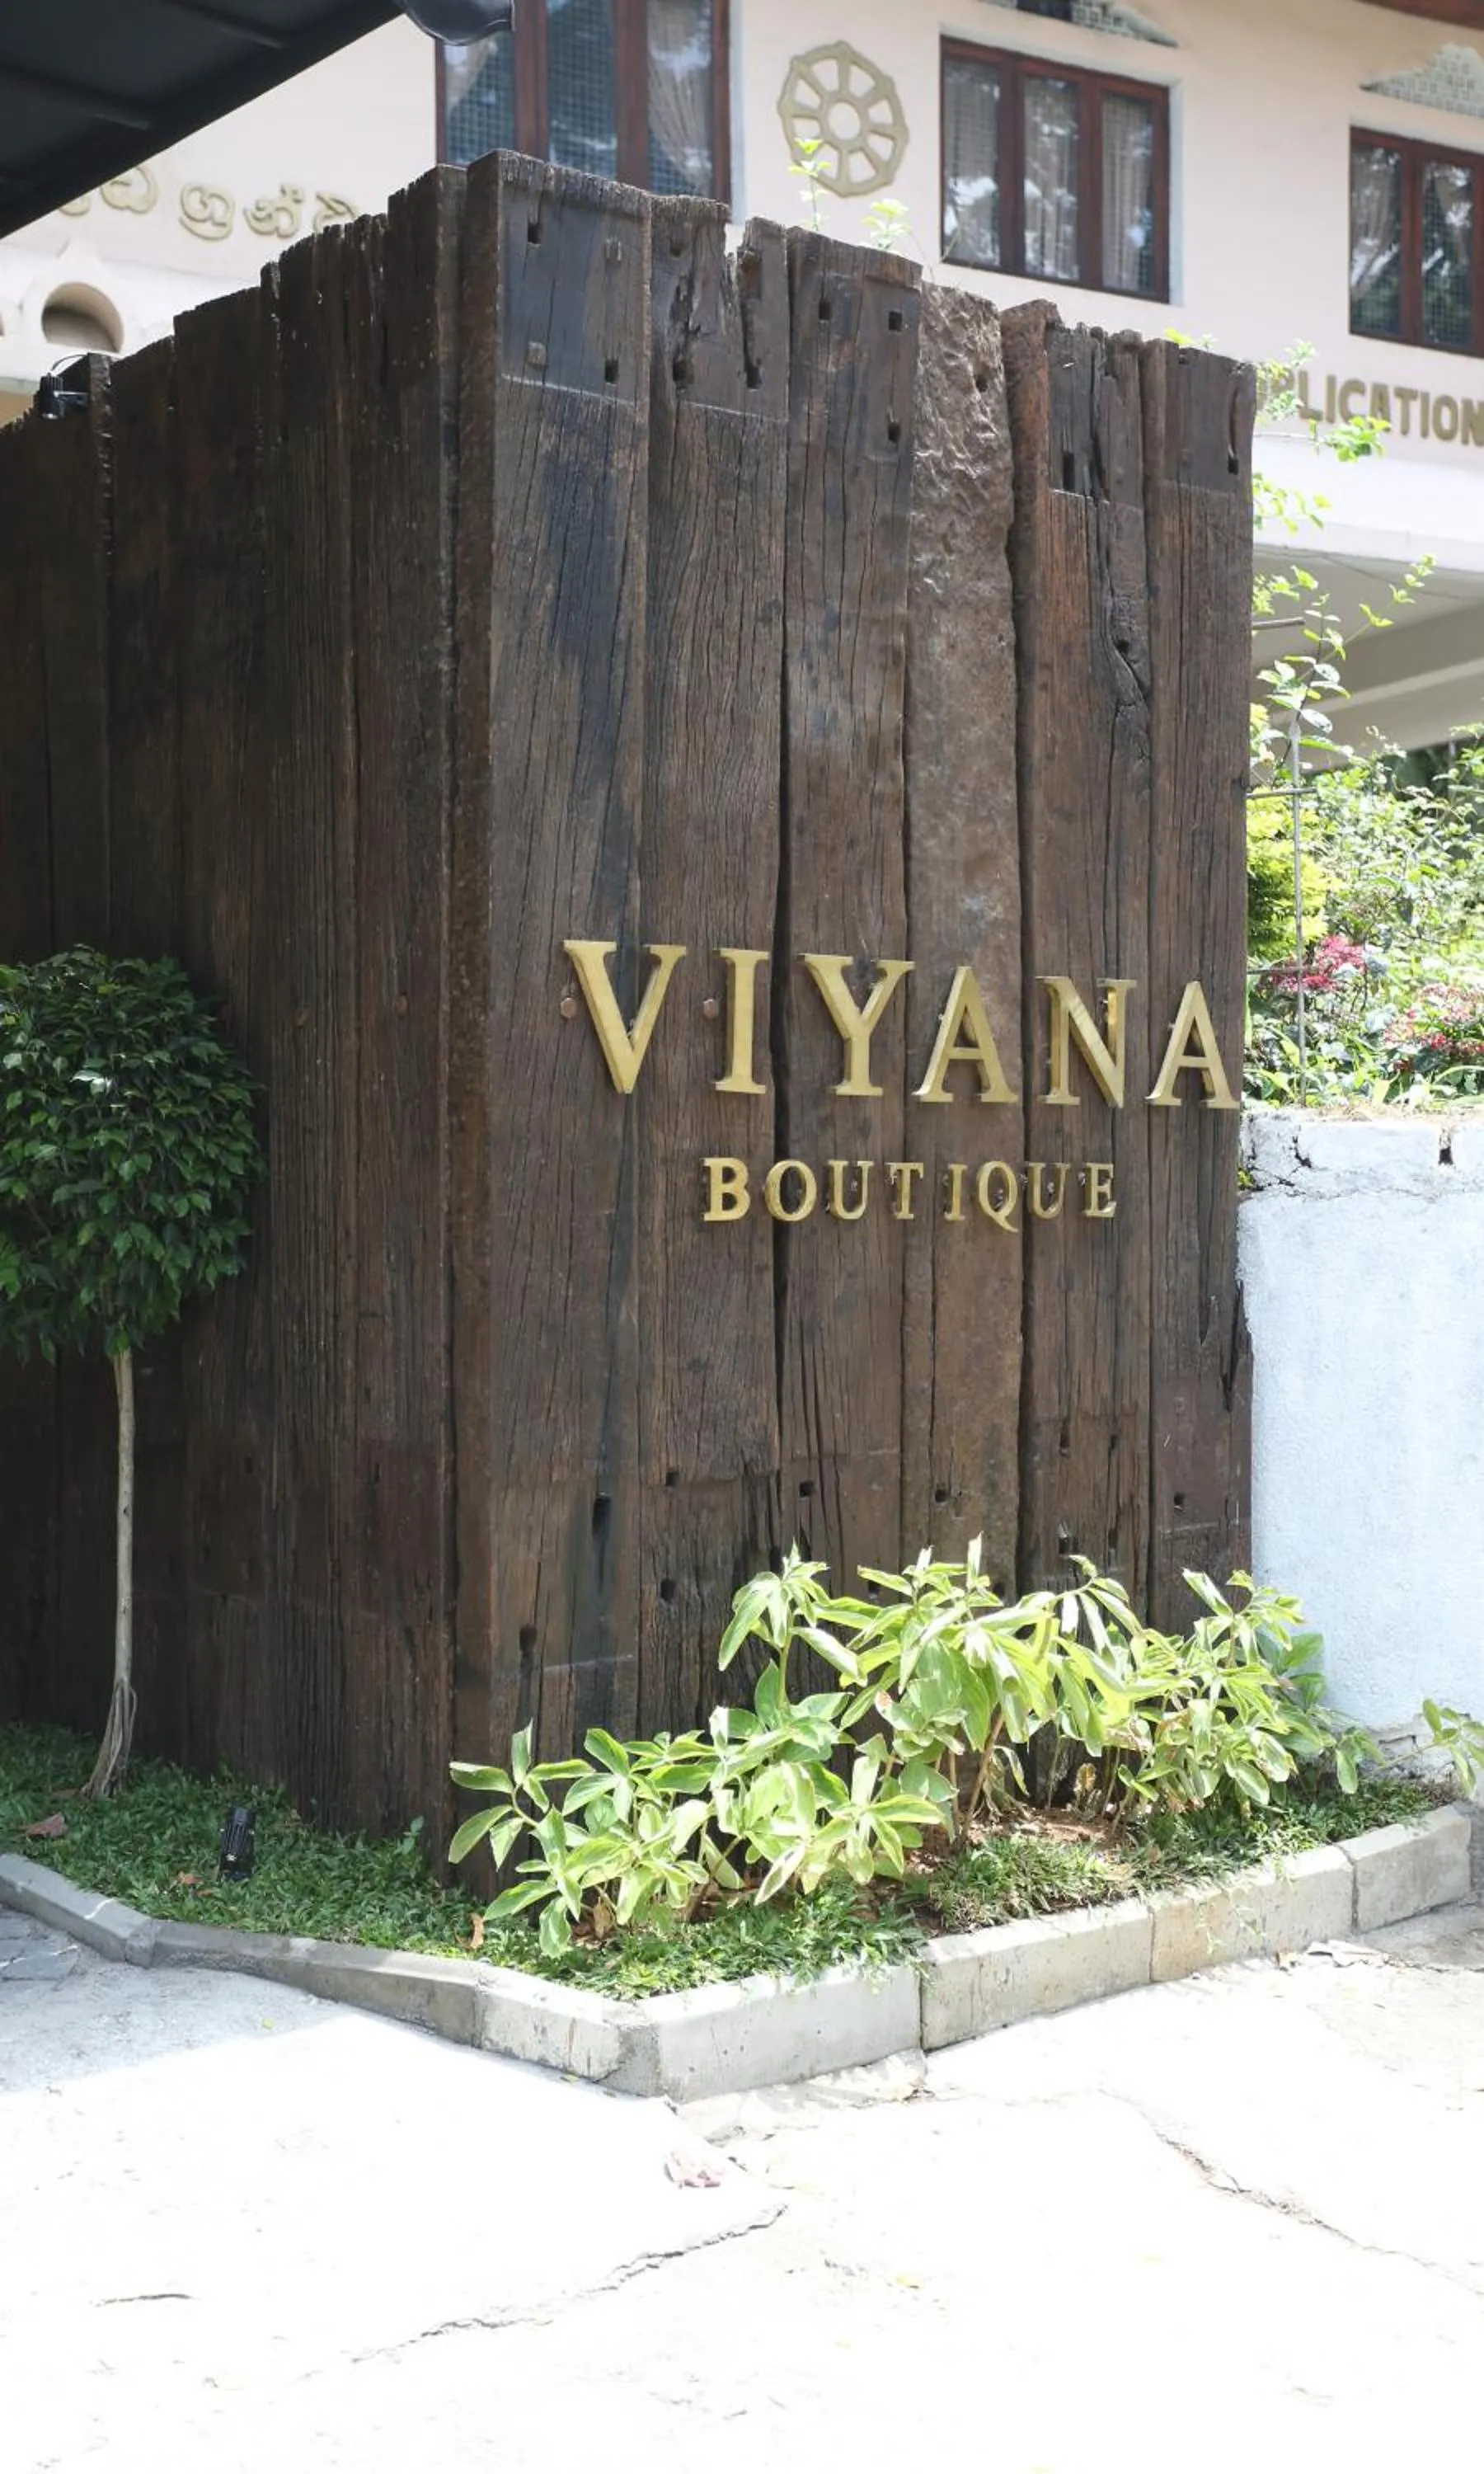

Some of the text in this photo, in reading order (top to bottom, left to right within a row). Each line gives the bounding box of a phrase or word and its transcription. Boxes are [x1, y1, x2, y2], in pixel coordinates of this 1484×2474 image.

[1256, 365, 1484, 447] LICATION
[563, 939, 1242, 1110] VIYANA
[702, 1157, 1118, 1232] BOUTIQUE
